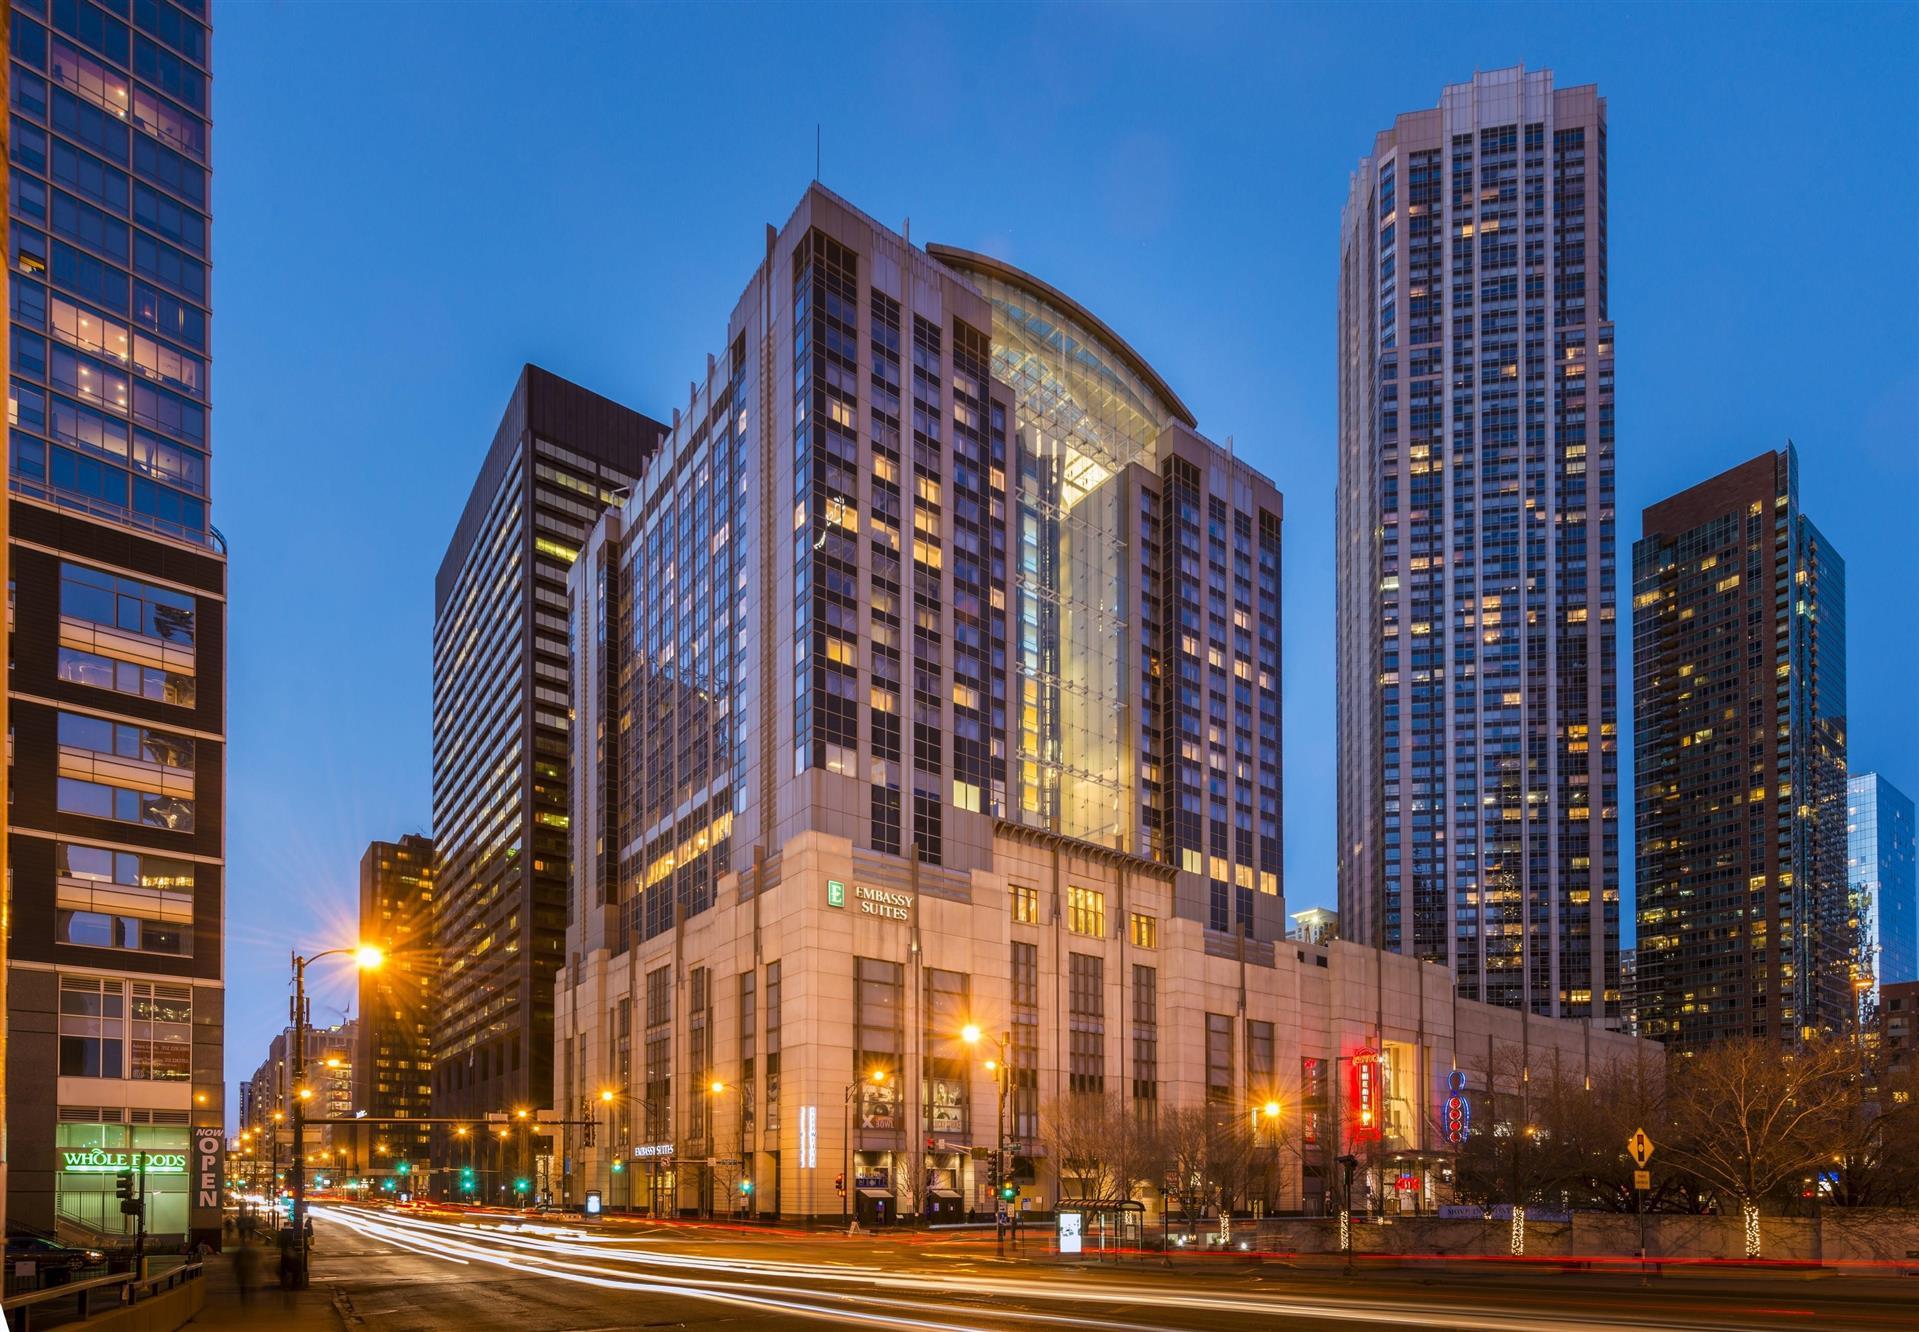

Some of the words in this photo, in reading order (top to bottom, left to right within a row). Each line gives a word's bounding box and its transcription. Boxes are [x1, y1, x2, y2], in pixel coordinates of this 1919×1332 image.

[856, 886, 913, 908] EMBASSY
[861, 901, 908, 920] SUITES
[196, 1128, 223, 1137] NOW
[64, 1149, 127, 1166] WHOLE
[131, 1154, 186, 1167] FOODS
[198, 1137, 219, 1207] OPEN
